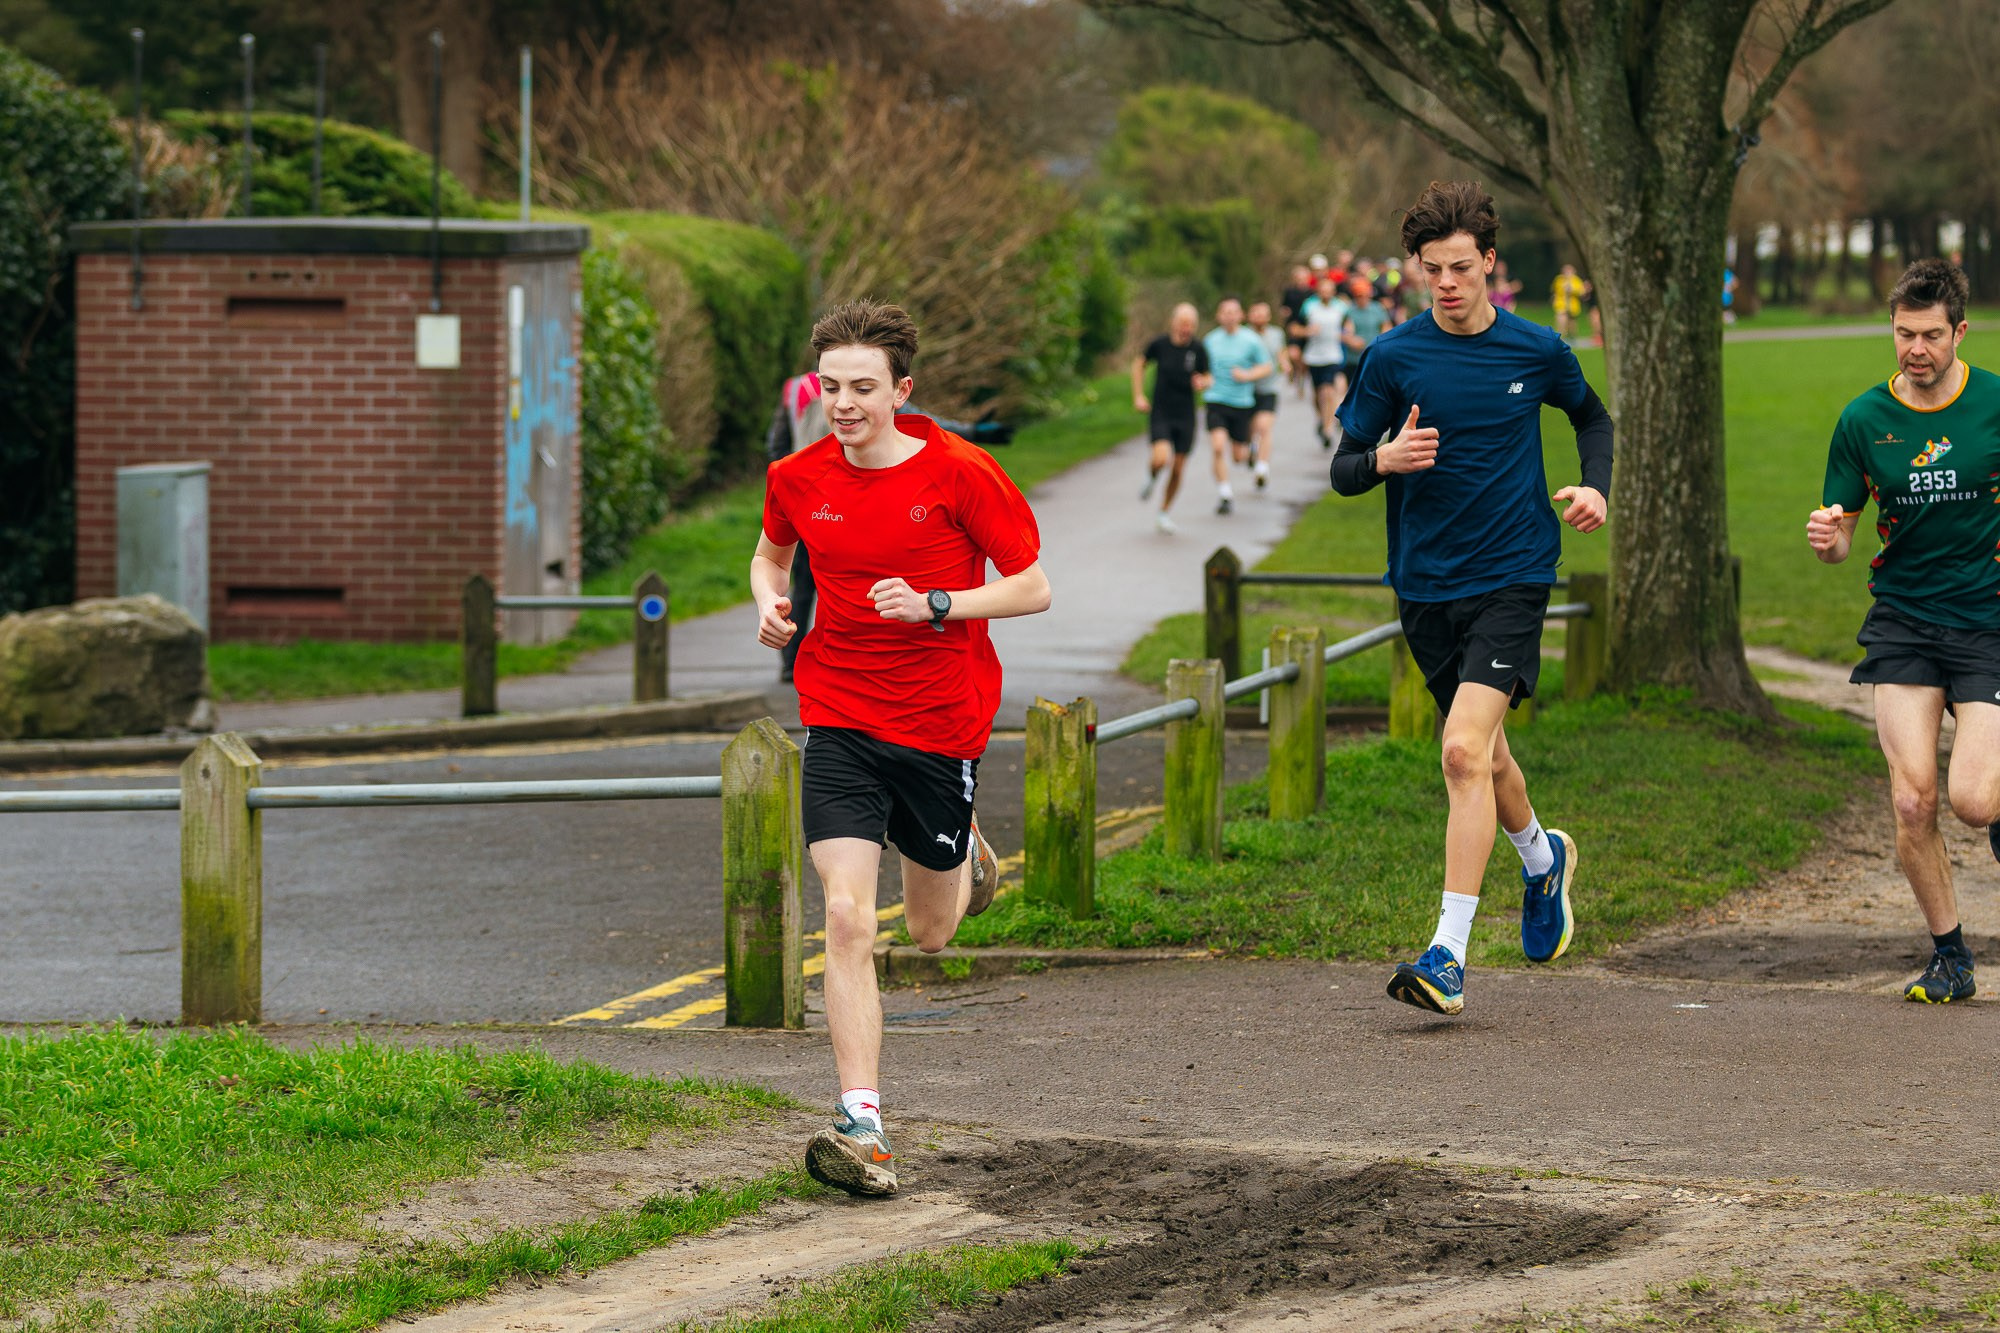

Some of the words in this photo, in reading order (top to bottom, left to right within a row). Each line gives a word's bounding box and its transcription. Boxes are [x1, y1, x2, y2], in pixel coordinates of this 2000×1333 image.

[1507, 382, 1524, 394] NB
[1908, 470, 1957, 492] 2353
[1895, 495, 1926, 505] TRAIL
[1928, 491, 1978, 503] RUNNERS
[811, 504, 844, 522] parkrun
